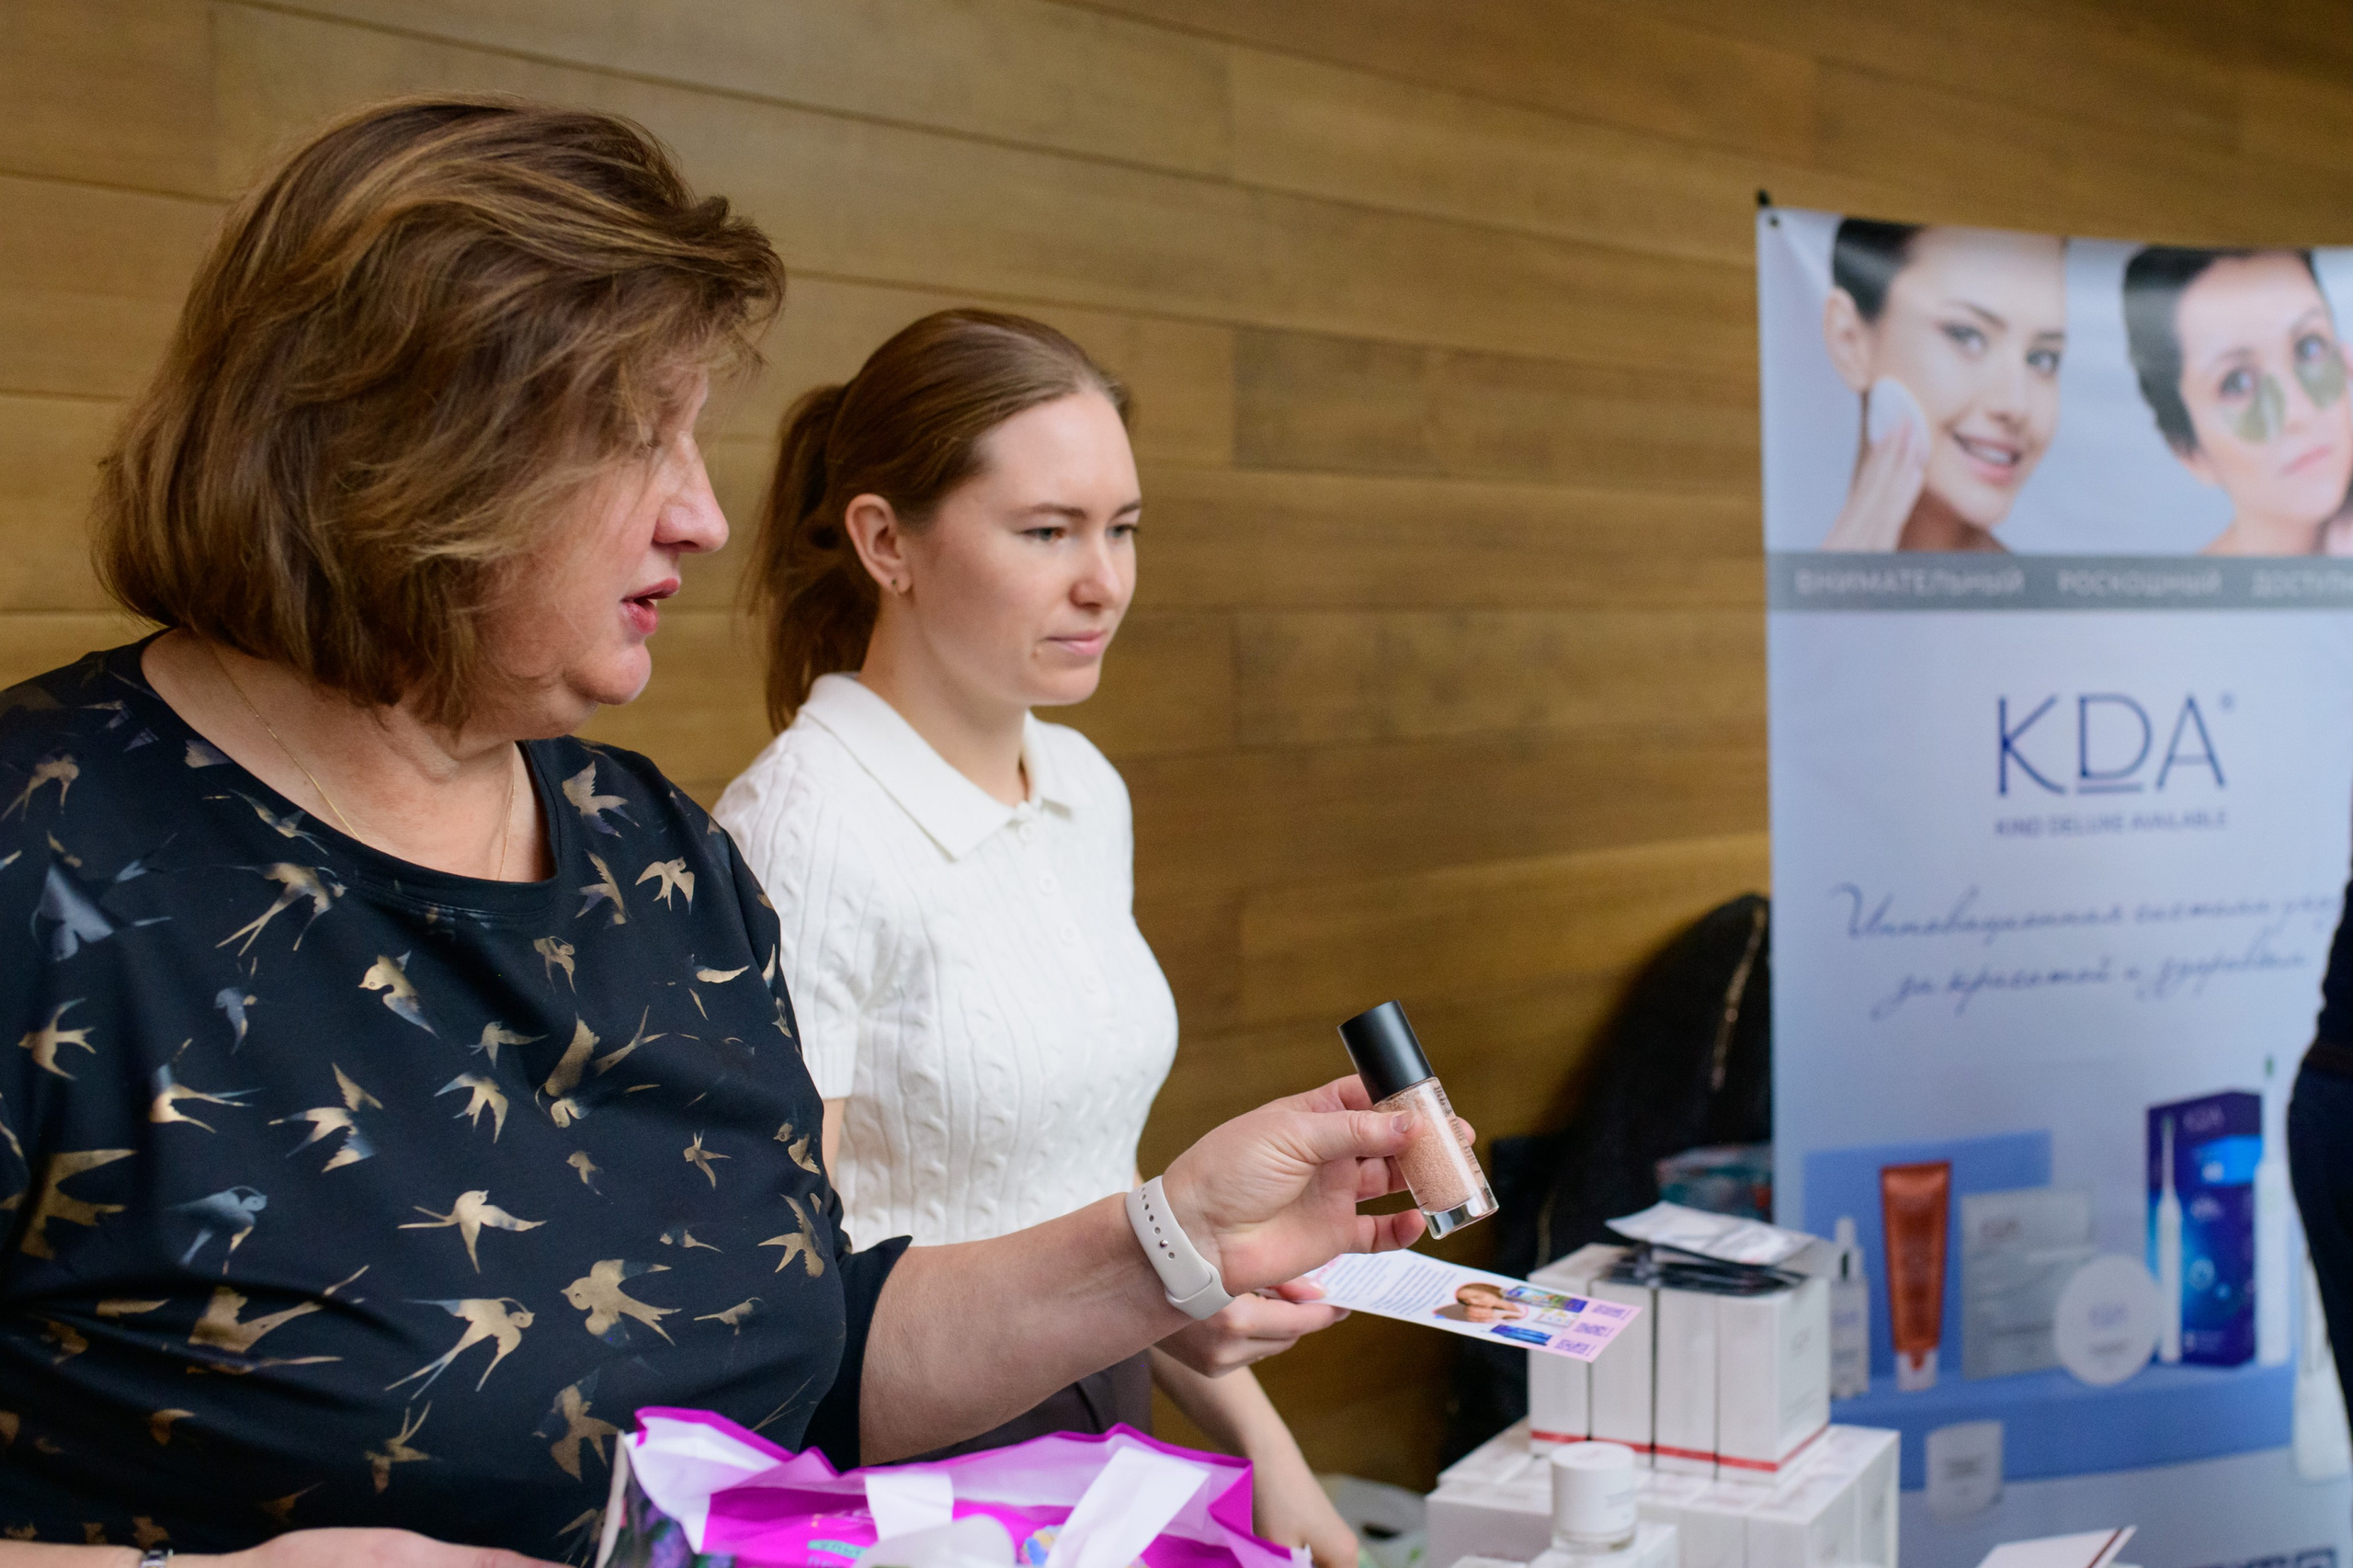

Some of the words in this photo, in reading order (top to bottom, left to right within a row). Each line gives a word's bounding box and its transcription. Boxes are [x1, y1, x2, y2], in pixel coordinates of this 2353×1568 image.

[1795, 564, 2025, 597] ВНИМАТЕЛЬНЫЙ
[2058, 566, 2222, 597] РОСКОШНЫЙ
[1997, 691, 2228, 796] KDA
